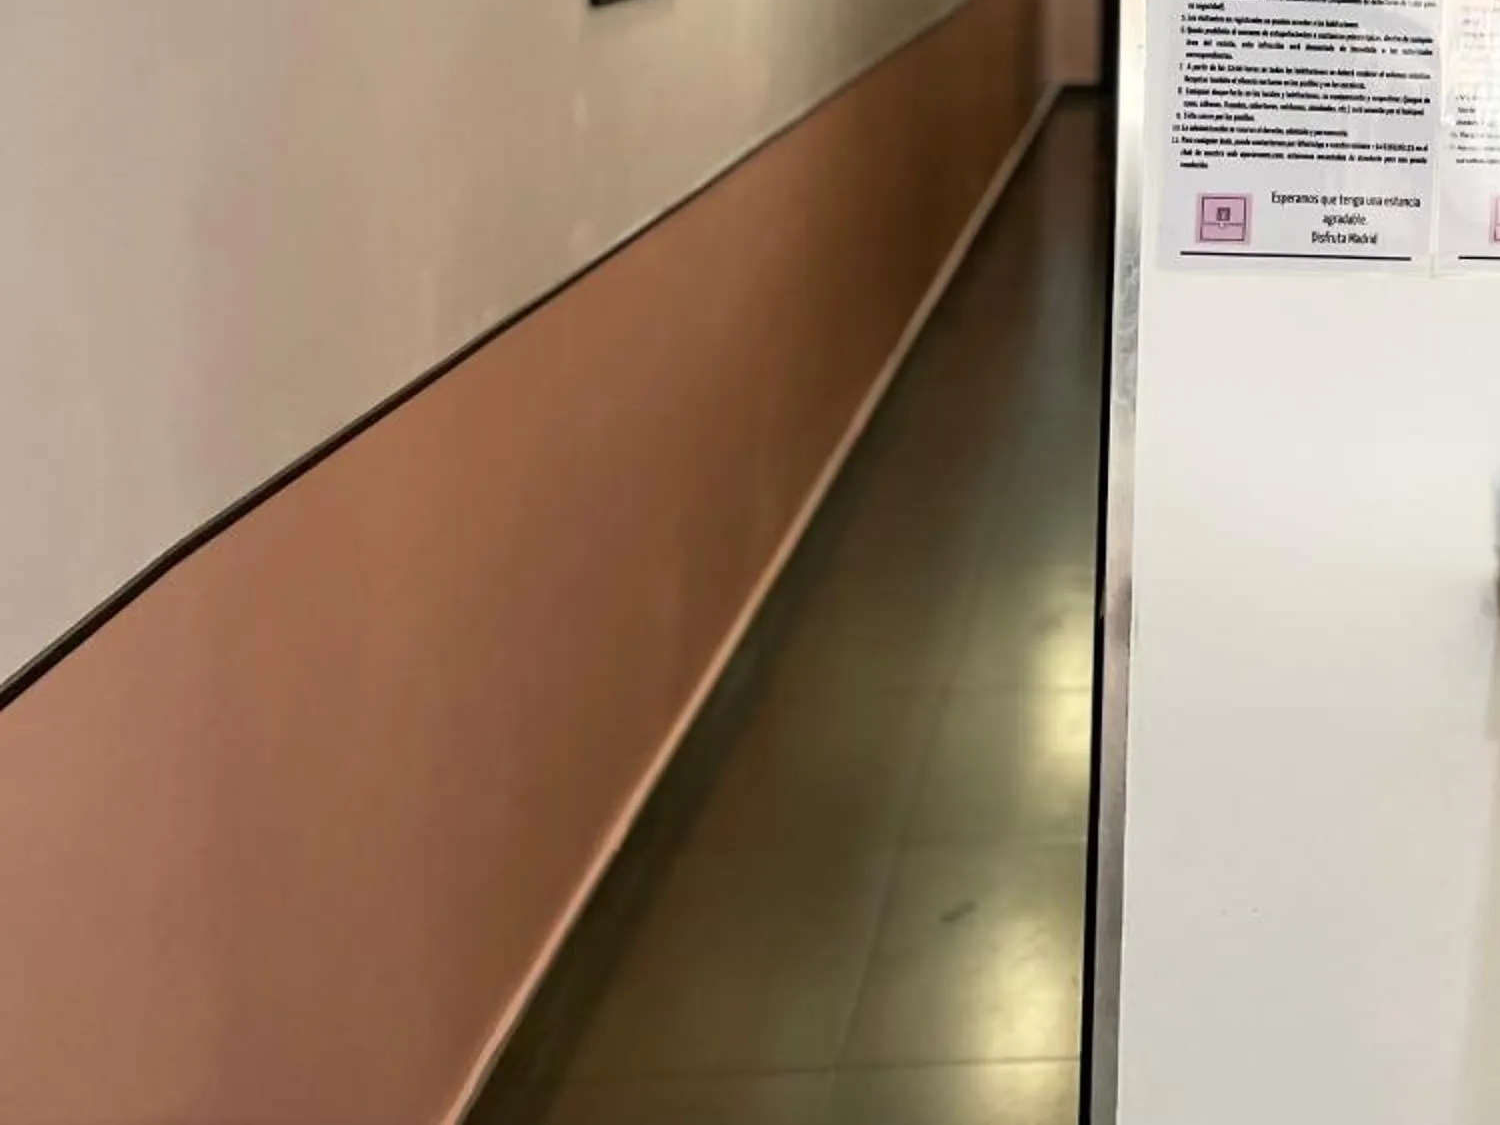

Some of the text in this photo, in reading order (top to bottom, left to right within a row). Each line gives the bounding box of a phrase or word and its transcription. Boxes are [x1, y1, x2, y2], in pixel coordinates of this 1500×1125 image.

[1271, 191, 1421, 208] Esperamos que tenga una estancia
[1311, 230, 1377, 244] Disfruta Madrid
